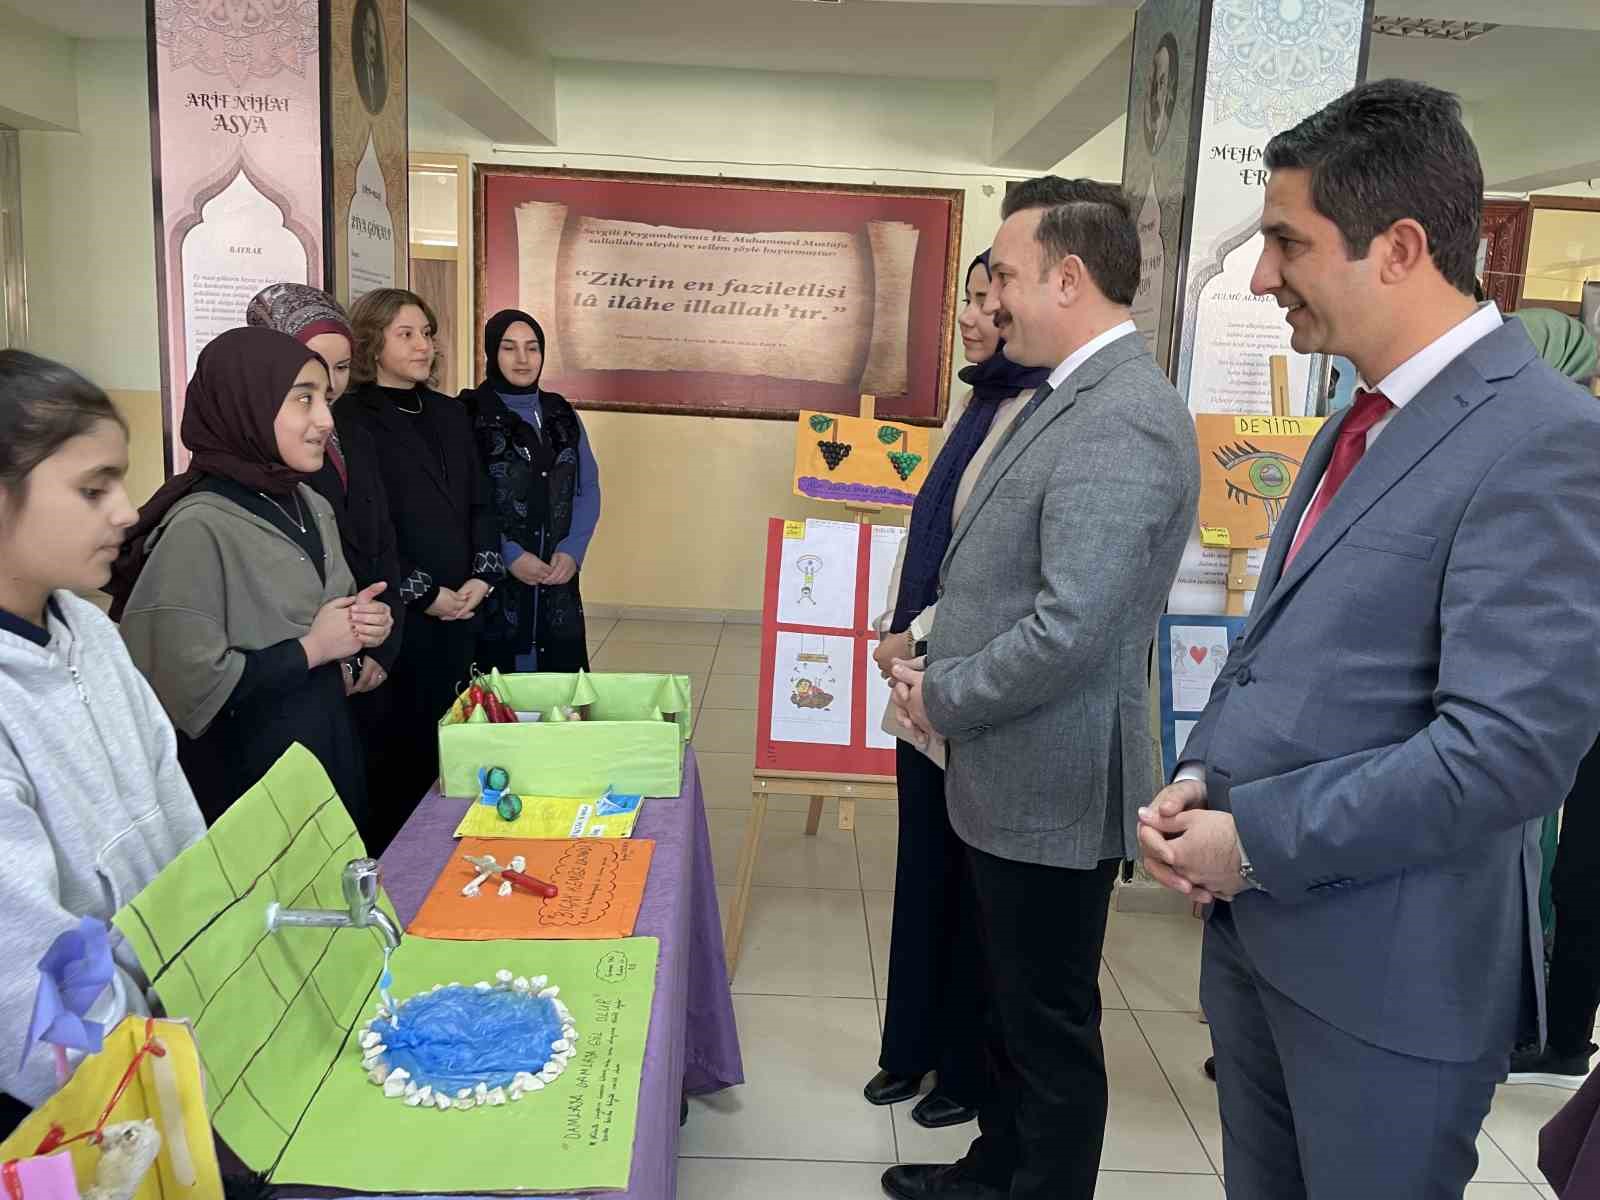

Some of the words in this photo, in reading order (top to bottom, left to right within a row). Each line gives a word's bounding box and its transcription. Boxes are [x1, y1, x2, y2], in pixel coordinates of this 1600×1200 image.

[185, 91, 230, 111] ARİF
[232, 92, 288, 113] NİHAT
[211, 114, 268, 137] ASYA
[1209, 144, 1263, 163] MEHM
[1240, 169, 1268, 186] ER
[575, 270, 675, 290] “Zikrin
[683, 280, 714, 292] en
[717, 278, 847, 299] faziletlisi
[573, 292, 598, 308] lâ
[608, 295, 675, 312] ilâhe
